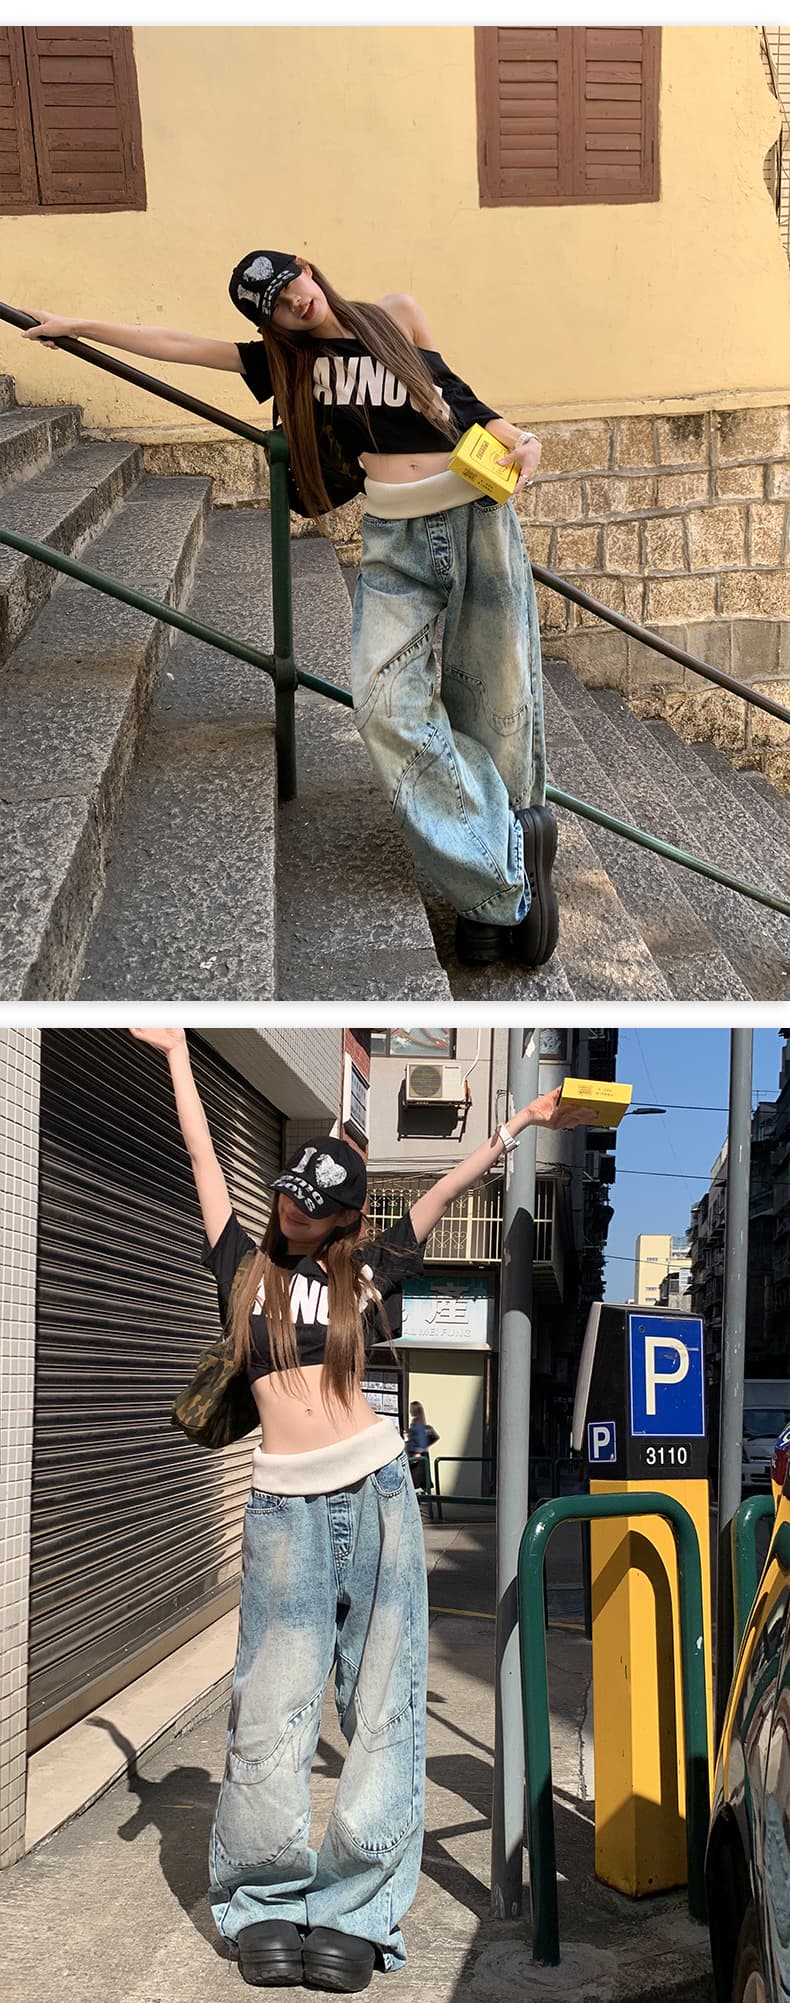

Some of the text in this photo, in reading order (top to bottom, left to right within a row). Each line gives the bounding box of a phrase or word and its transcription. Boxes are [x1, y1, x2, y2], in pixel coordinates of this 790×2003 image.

[291, 1146, 317, 1173] I
[645, 1336, 690, 1415] P
[592, 1427, 611, 1458] P
[646, 1447, 687, 1465] 3110
